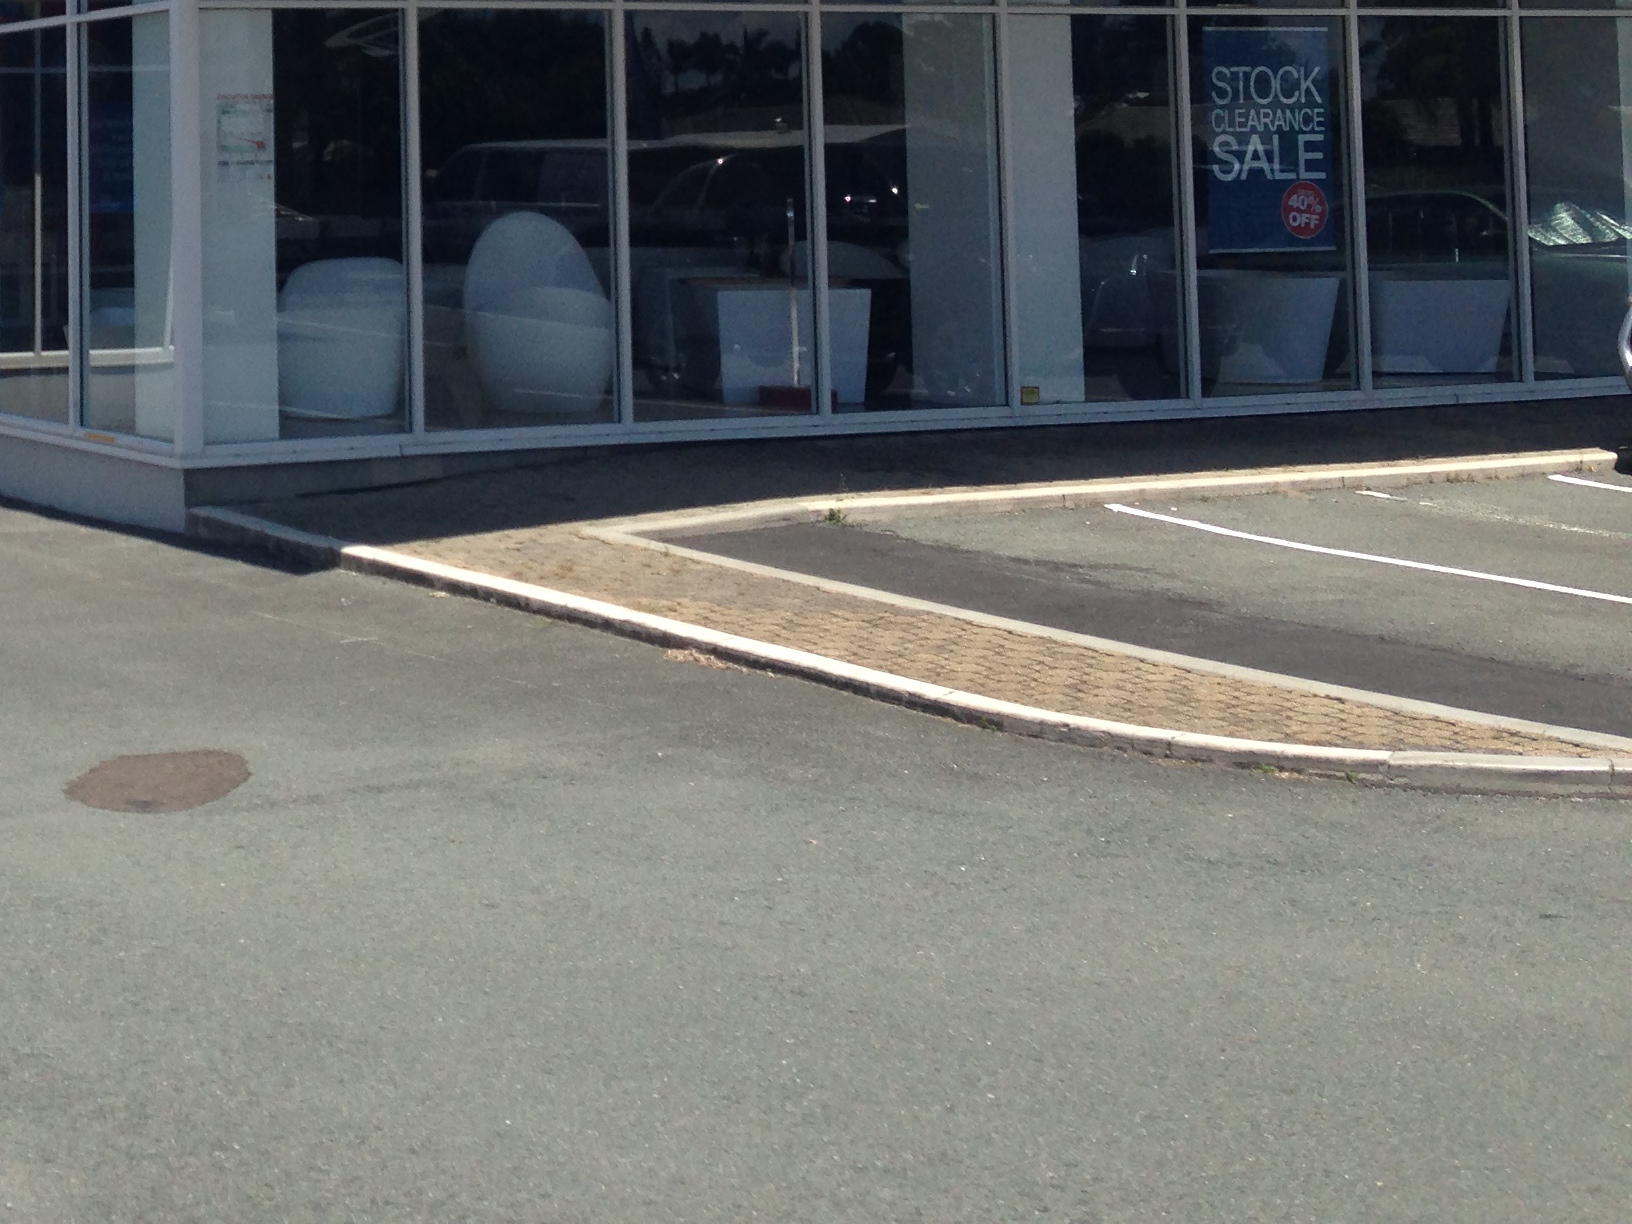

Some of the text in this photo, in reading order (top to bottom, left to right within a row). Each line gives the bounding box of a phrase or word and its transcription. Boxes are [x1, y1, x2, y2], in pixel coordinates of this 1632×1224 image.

[1211, 66, 1323, 105] STOCK
[1211, 108, 1325, 131] CLEARANCE
[1212, 133, 1326, 182] SALE
[1288, 194, 1322, 213] 40%
[1288, 211, 1320, 229] OFF
